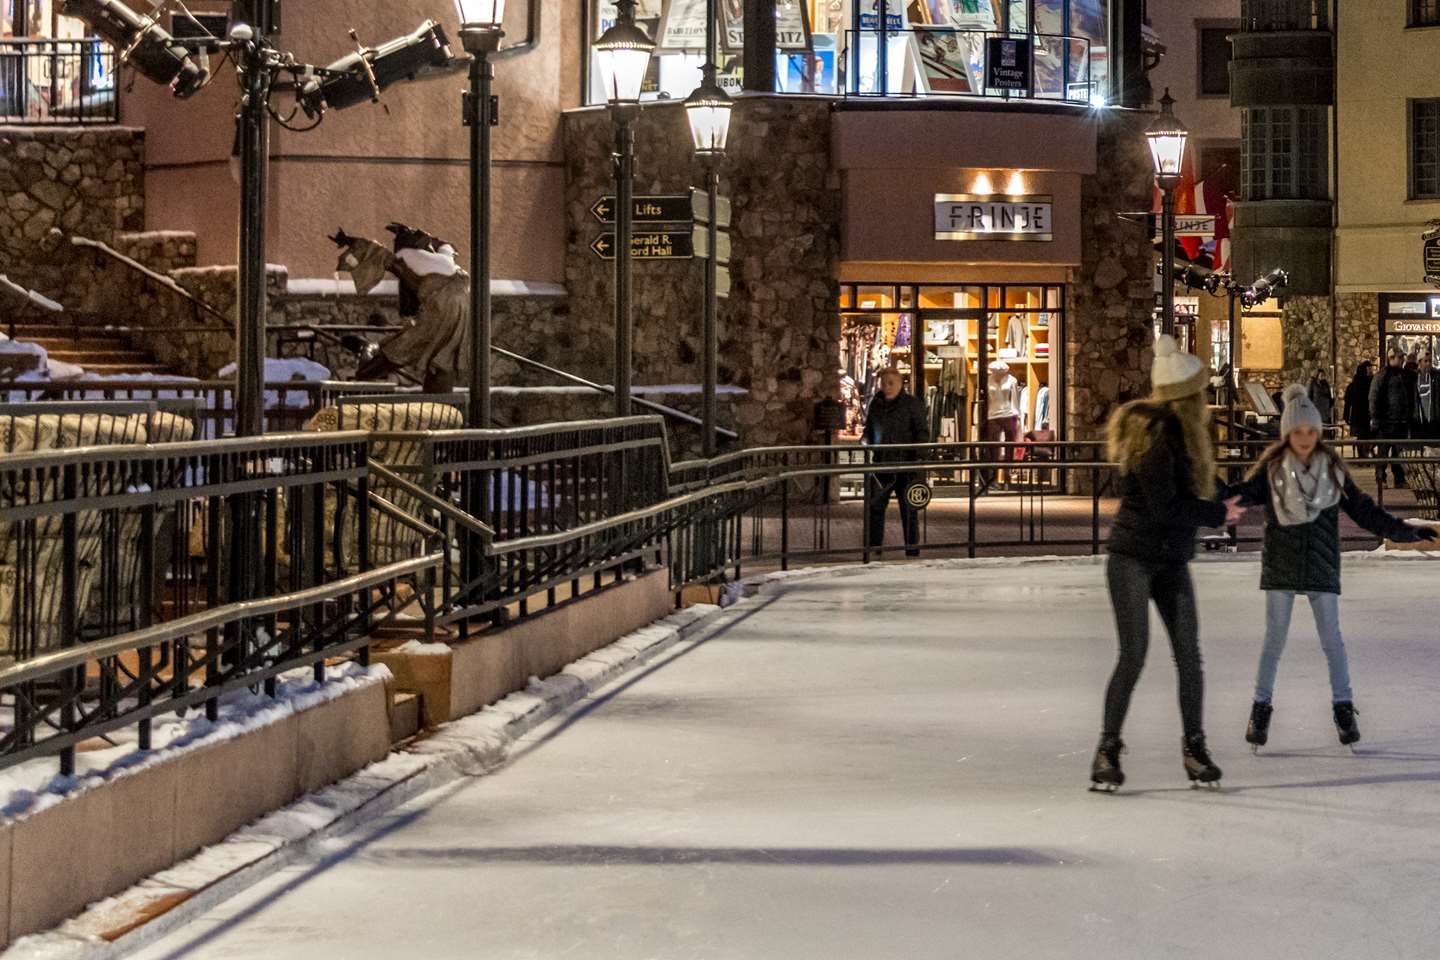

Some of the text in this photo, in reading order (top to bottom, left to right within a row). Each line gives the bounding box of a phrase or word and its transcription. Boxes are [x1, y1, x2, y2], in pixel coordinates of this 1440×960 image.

[993, 67, 1024, 78] Vintage
[994, 78, 1022, 87] Posters
[635, 204, 663, 216] Lifts
[949, 205, 1044, 230] FRINJE
[1174, 220, 1209, 231] INJE
[662, 234, 673, 245] R.
[631, 245, 673, 256] ord Hall
